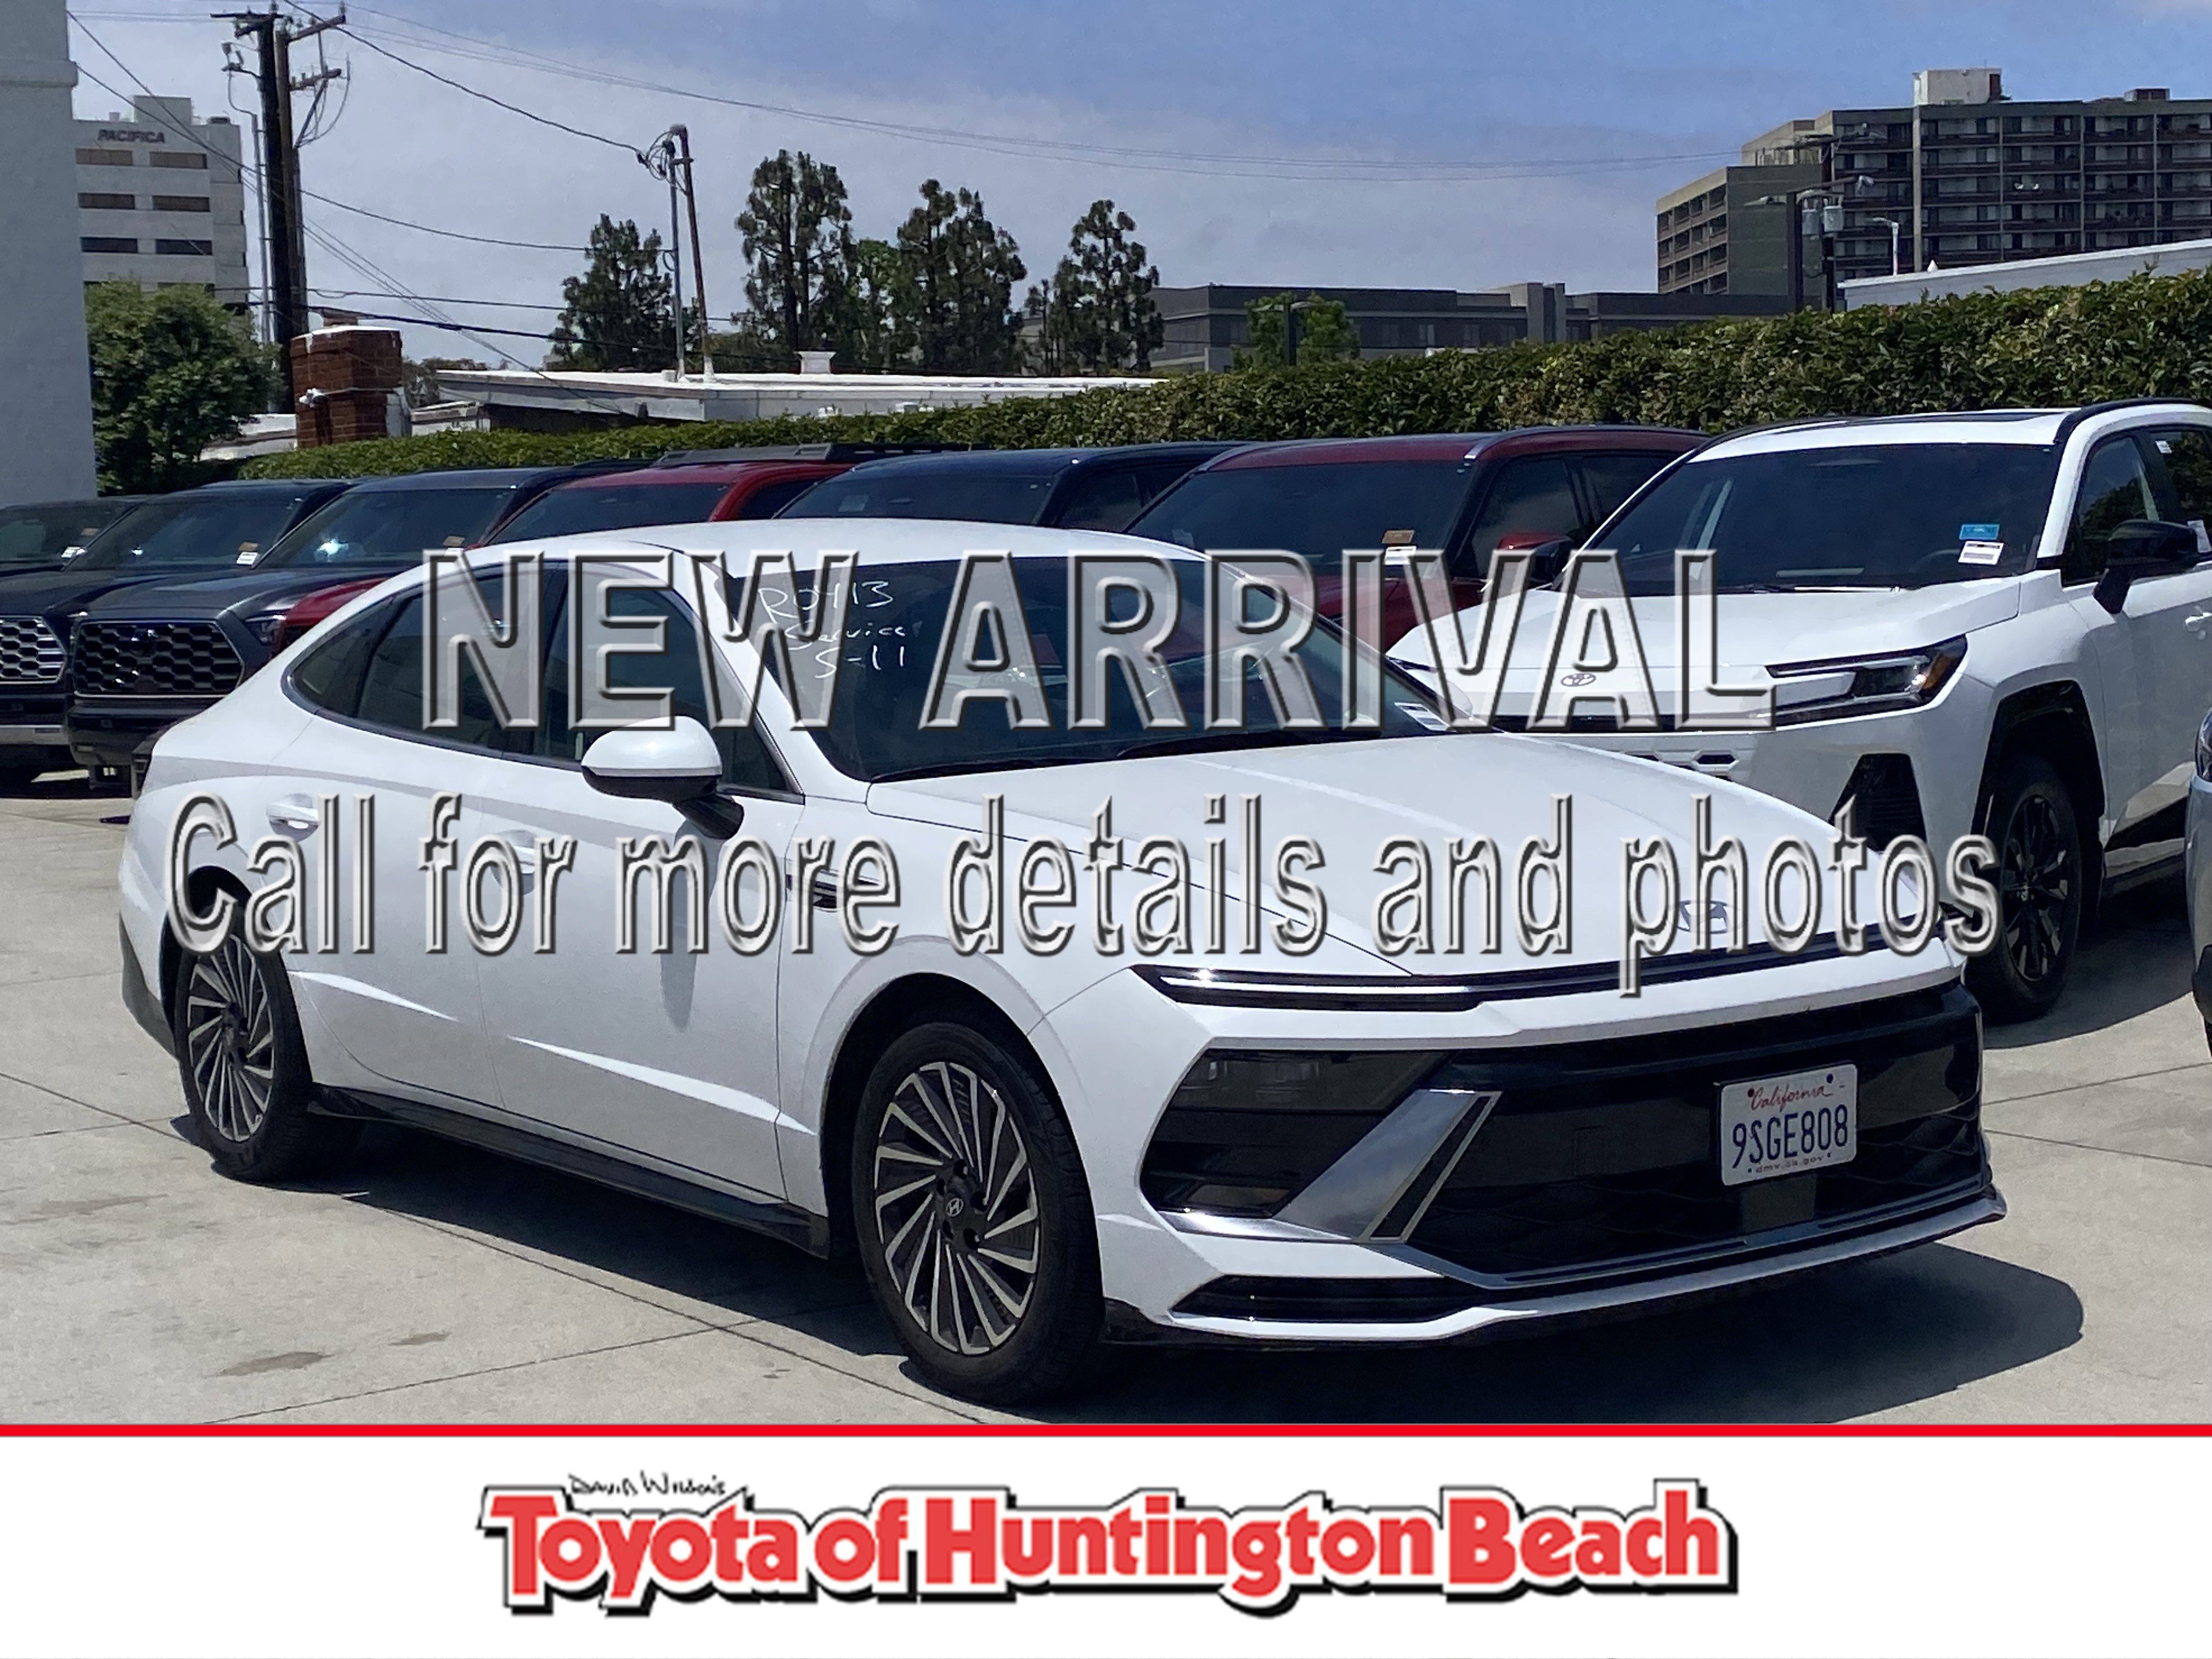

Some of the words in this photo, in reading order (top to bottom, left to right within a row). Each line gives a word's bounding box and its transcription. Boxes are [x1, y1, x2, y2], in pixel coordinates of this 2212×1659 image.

[98, 129, 165, 143] PACIFICA
[1750, 1083, 1833, 1112] California
[1732, 1104, 1848, 1169] 9SGE808
